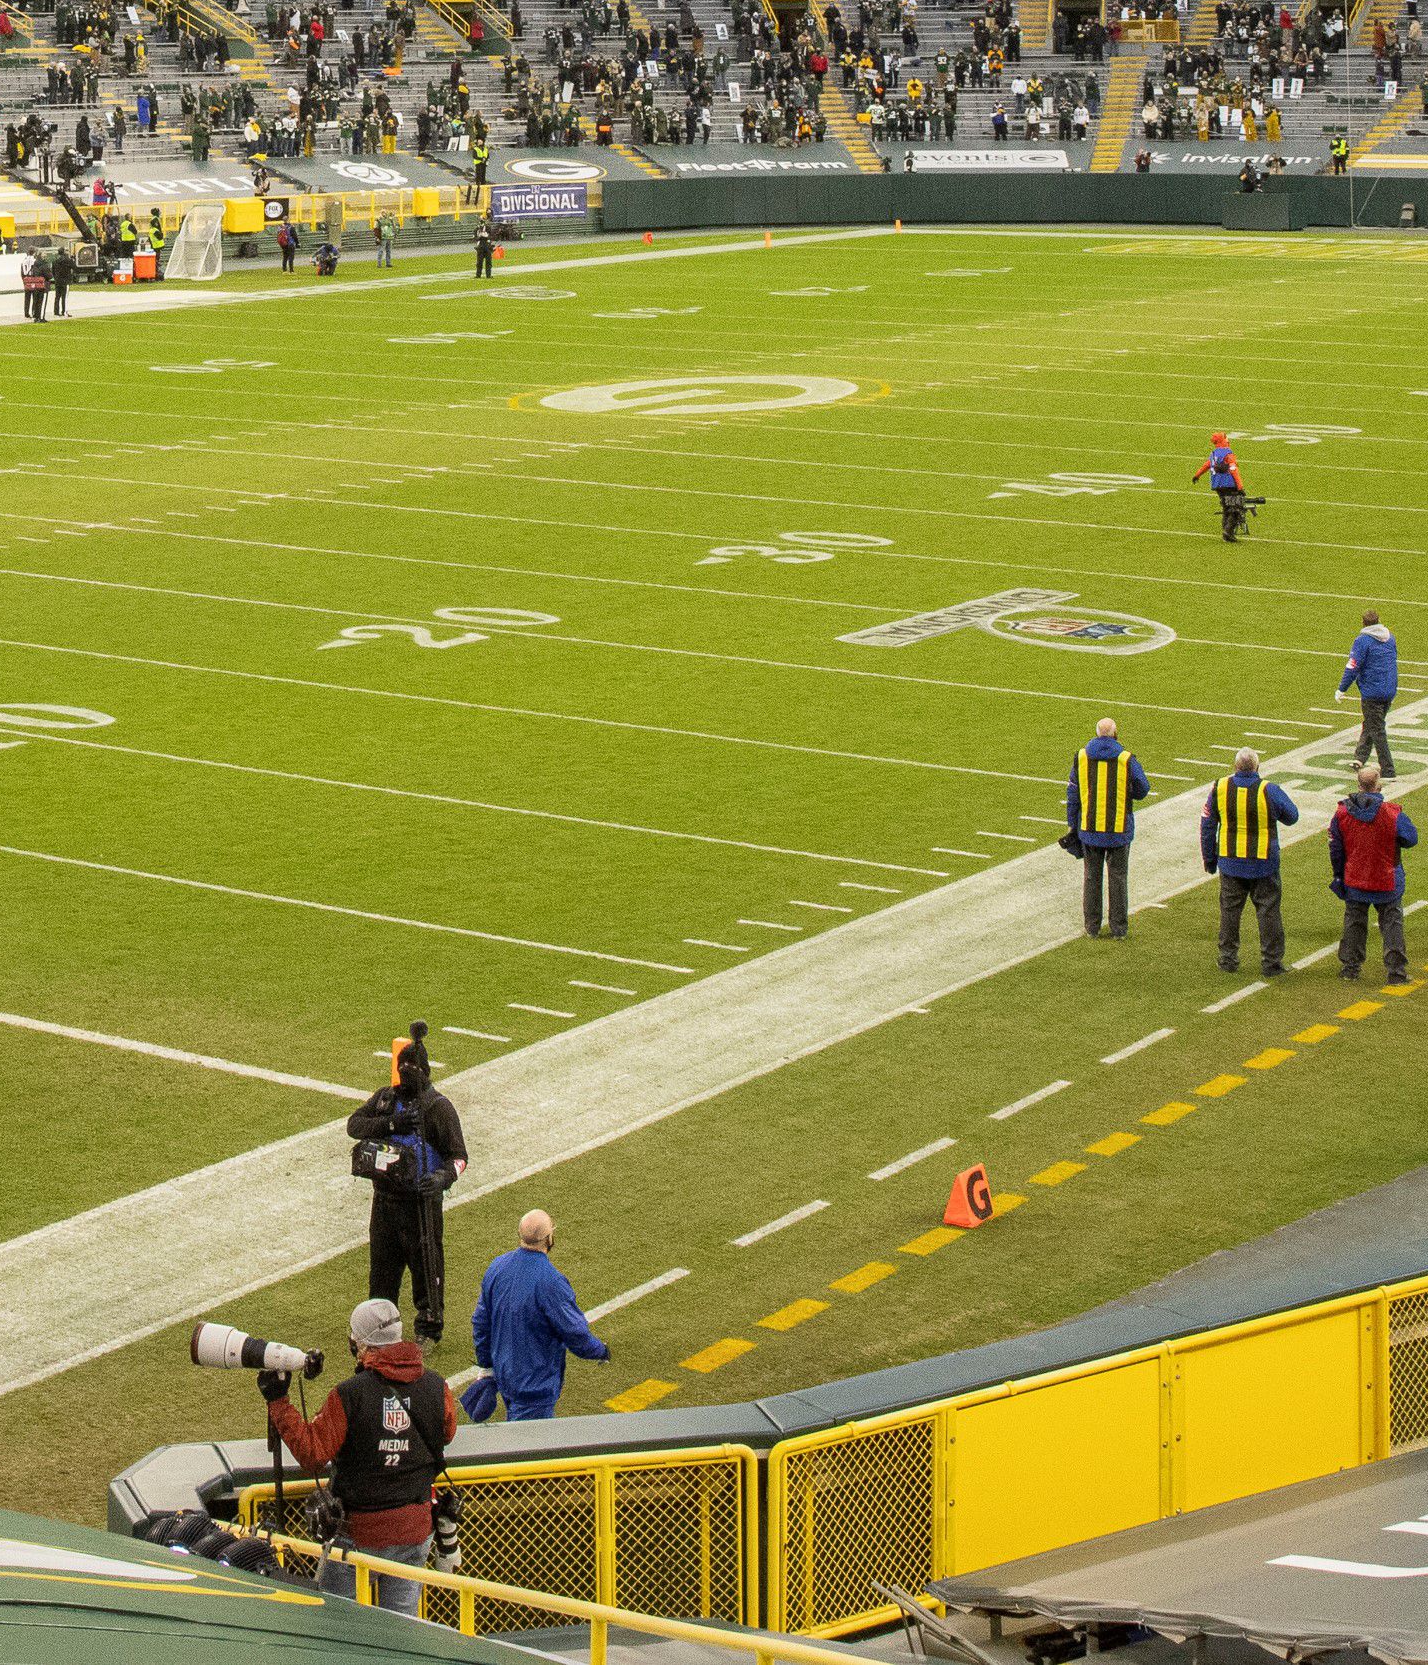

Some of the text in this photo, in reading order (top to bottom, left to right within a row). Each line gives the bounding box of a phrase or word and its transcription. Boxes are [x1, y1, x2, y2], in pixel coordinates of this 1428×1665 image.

[500, 193, 579, 213] DIVISIONAL
[720, 530, 895, 565] 30
[339, 606, 562, 651] 20
[966, 1166, 993, 1220] G
[386, 1411, 408, 1427] NFL
[378, 1438, 409, 1453] MEDIA
[384, 1453, 400, 1466] 22
